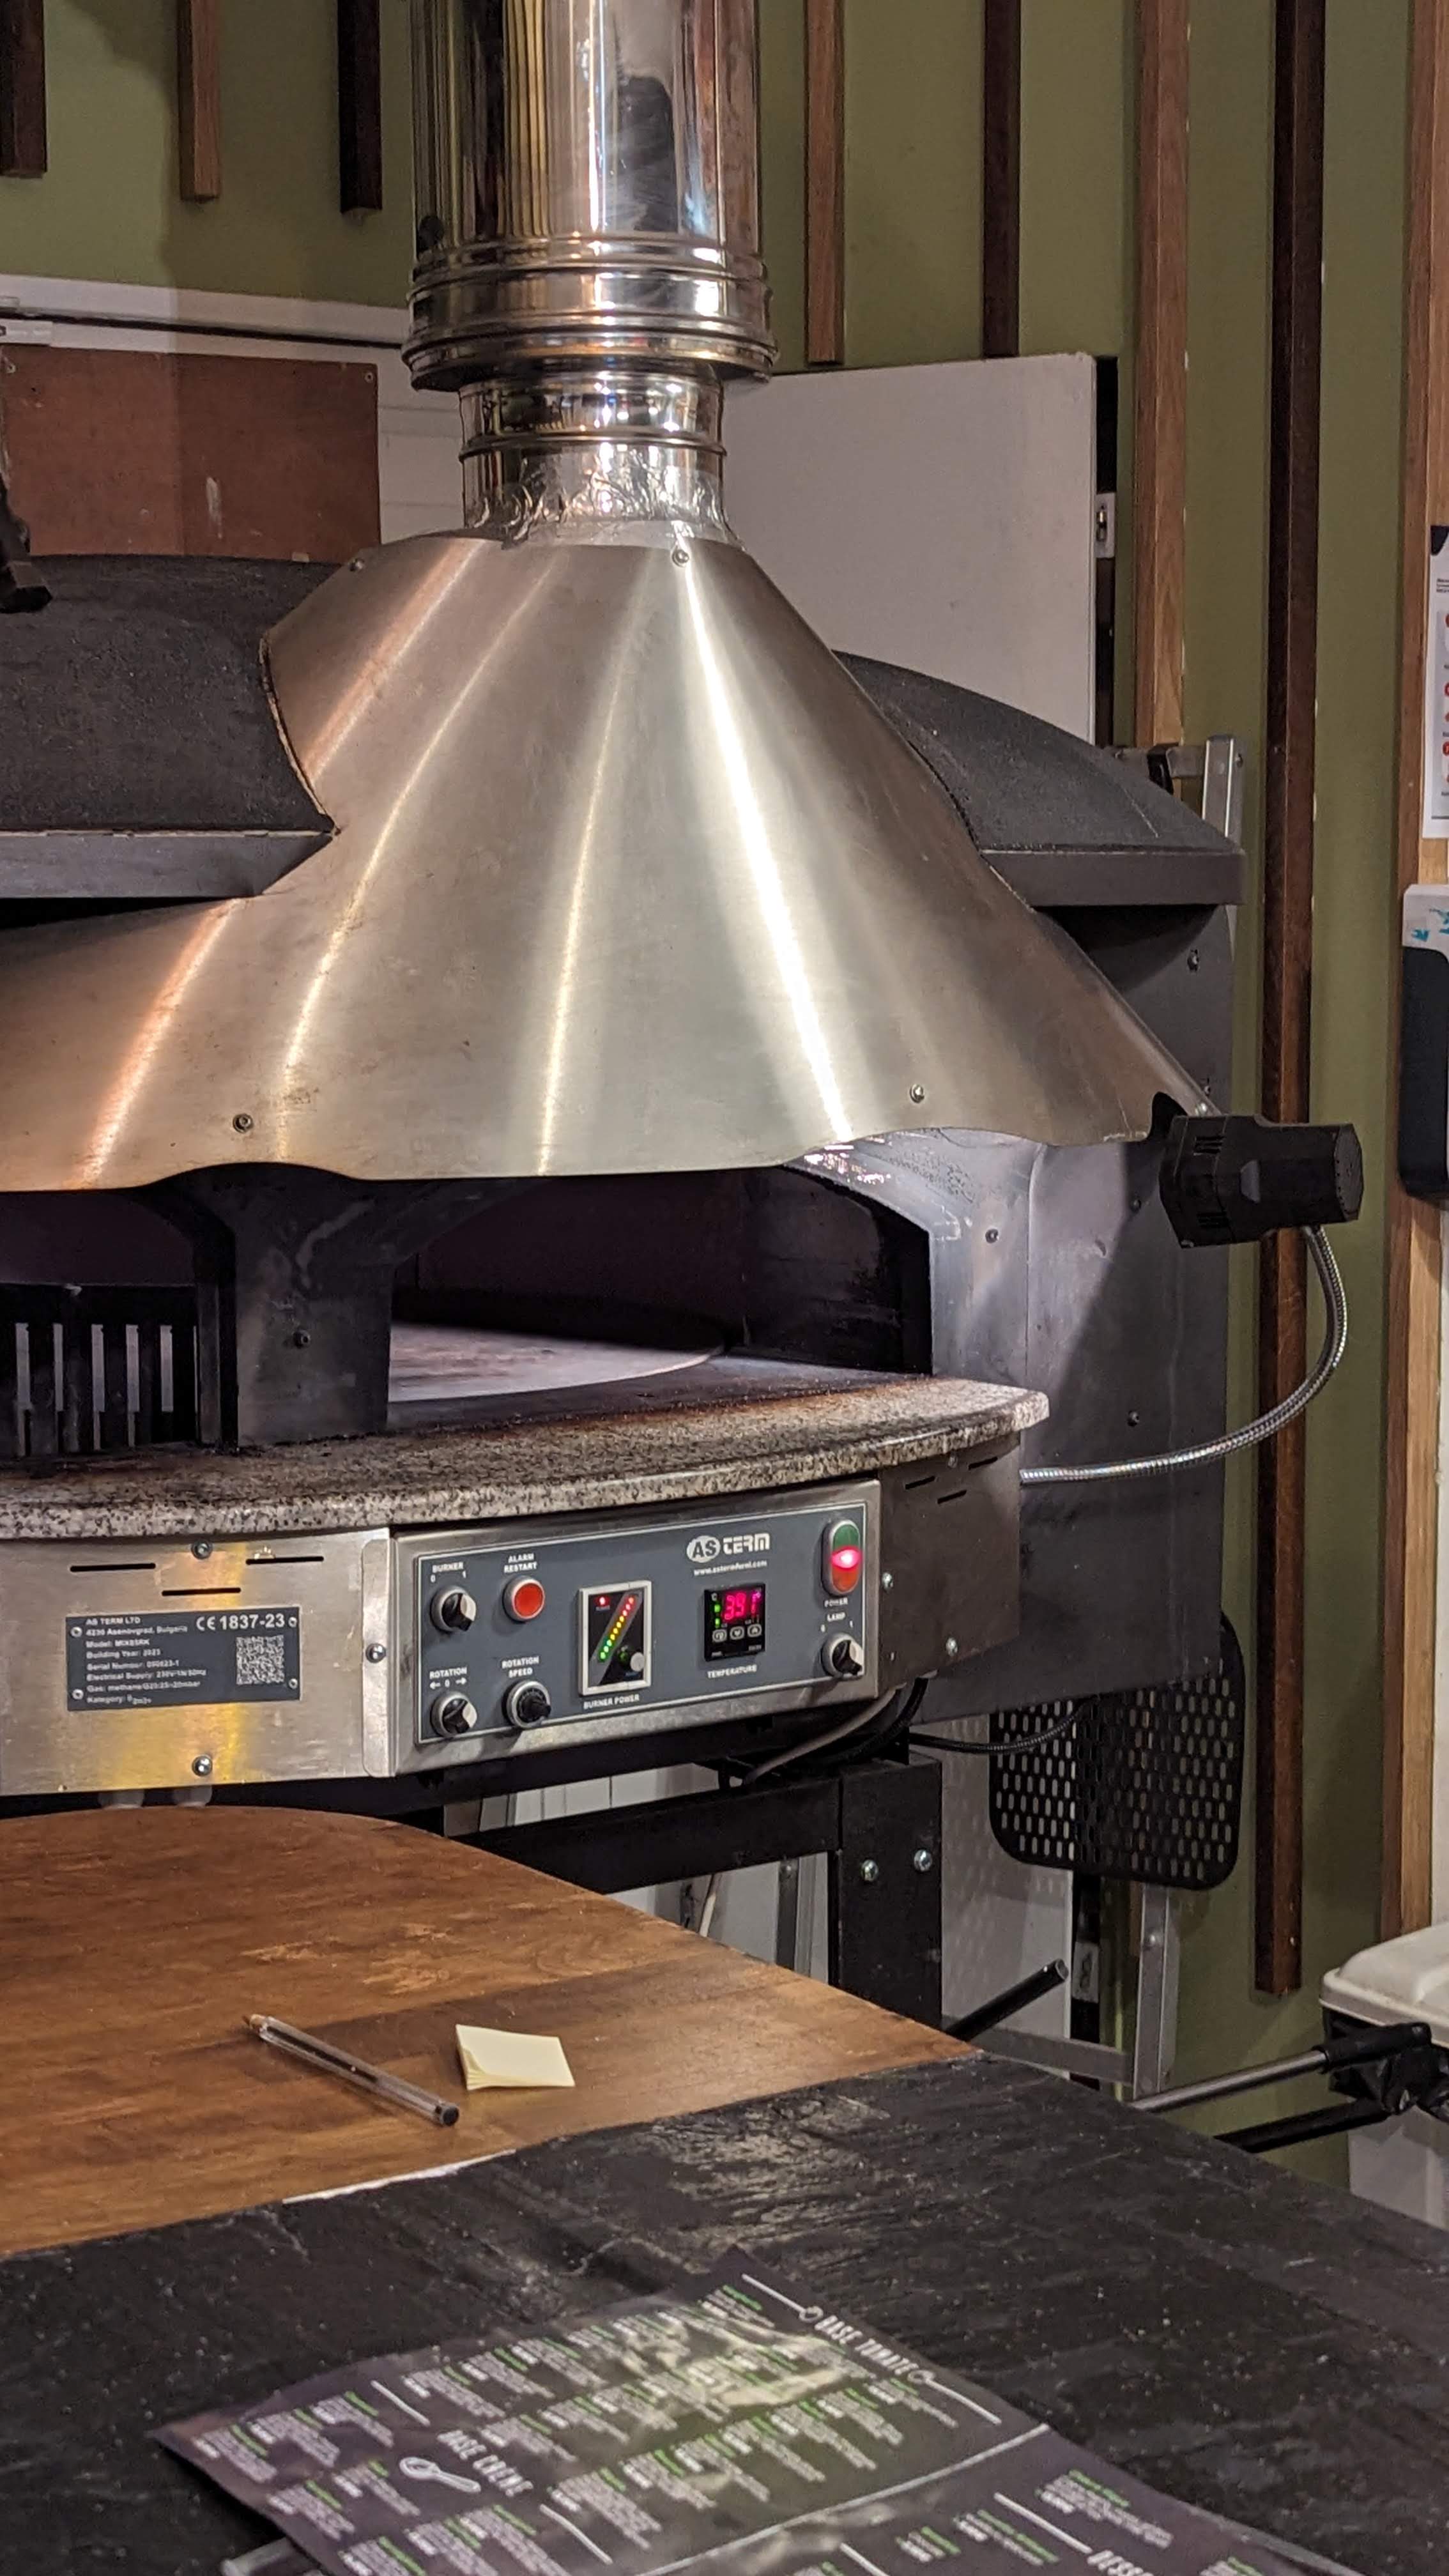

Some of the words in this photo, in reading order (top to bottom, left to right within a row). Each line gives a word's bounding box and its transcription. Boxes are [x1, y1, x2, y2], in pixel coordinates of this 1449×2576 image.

[690, 1538, 717, 1560] AS
[723, 1533, 770, 1554] TERM
[508, 1553, 534, 1564] ALARM
[432, 1561, 464, 1574] BURNER
[503, 1561, 537, 1573] RESTART
[430, 1574, 436, 1583] 0
[100, 1617, 124, 1625] TERM
[219, 1613, 285, 1630] 1837-23
[502, 1656, 539, 1669] ROTATION
[429, 1666, 468, 1680] ROTATION
[509, 1667, 533, 1678] SPEED
[707, 1664, 757, 1678] TEMPERATURE
[445, 1680, 450, 1688] 0
[583, 1698, 613, 1710] BURNER
[614, 1694, 640, 1705] POWER
